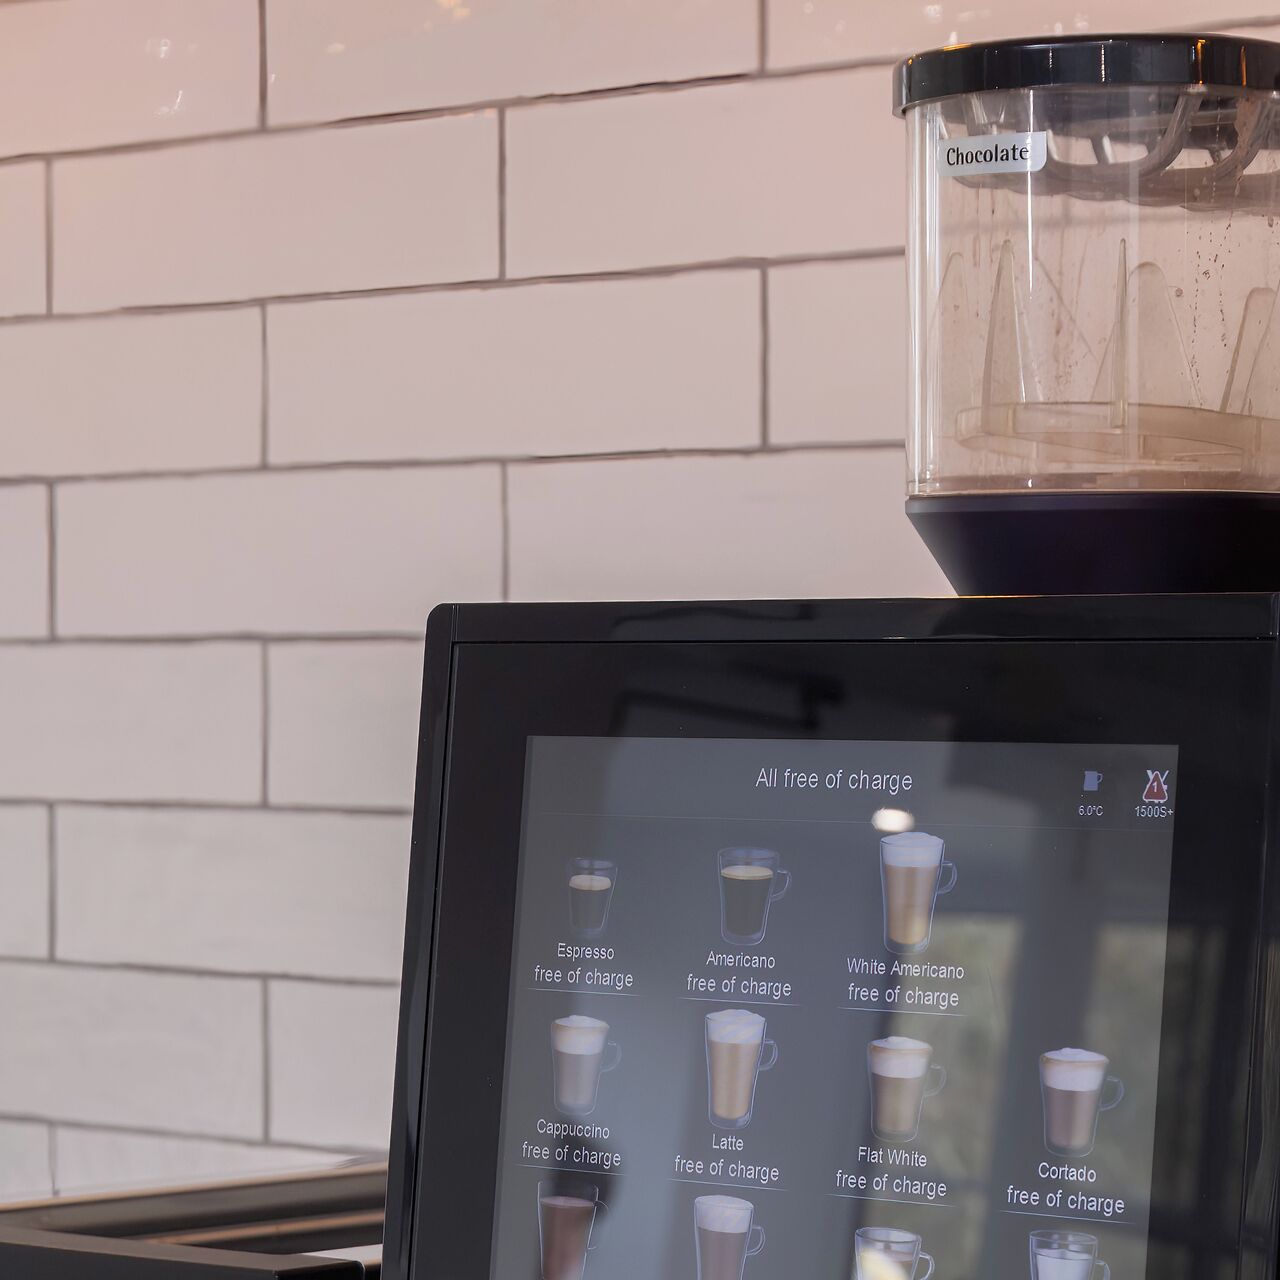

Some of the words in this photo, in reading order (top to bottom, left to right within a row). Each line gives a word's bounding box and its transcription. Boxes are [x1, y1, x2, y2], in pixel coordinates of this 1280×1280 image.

[946, 143, 1030, 166] Chocolate
[755, 767, 778, 788] All
[784, 768, 819, 788] free
[825, 769, 843, 789] of
[848, 769, 913, 796] charge
[1134, 805, 1175, 818] 1500S+
[557, 942, 615, 962] Espresso
[705, 950, 776, 969] Americano
[534, 965, 562, 983] free
[567, 967, 582, 984] of
[585, 968, 634, 990] charge
[847, 957, 886, 975] White
[890, 960, 965, 979] Americano
[686, 974, 716, 992] free
[721, 976, 737, 993] of
[740, 977, 792, 1000] charge
[848, 982, 879, 1001] free
[885, 985, 901, 1003] of
[905, 986, 959, 1010] charge
[536, 1118, 610, 1140] Cappuccino
[711, 1133, 744, 1151] Latte
[522, 1141, 550, 1159] free
[555, 1144, 570, 1161] of
[573, 1146, 621, 1170] charge
[857, 1146, 883, 1163] Flat
[887, 1148, 928, 1167] White
[674, 1154, 704, 1173] free
[709, 1158, 724, 1176] of
[728, 1160, 780, 1184] charge
[1037, 1161, 1097, 1183] Cortado
[835, 1169, 867, 1189] free
[872, 1173, 889, 1191] of
[893, 1175, 947, 1200] charge
[1006, 1185, 1040, 1205] free
[1046, 1189, 1063, 1209] of
[1067, 1192, 1126, 1217] charge
